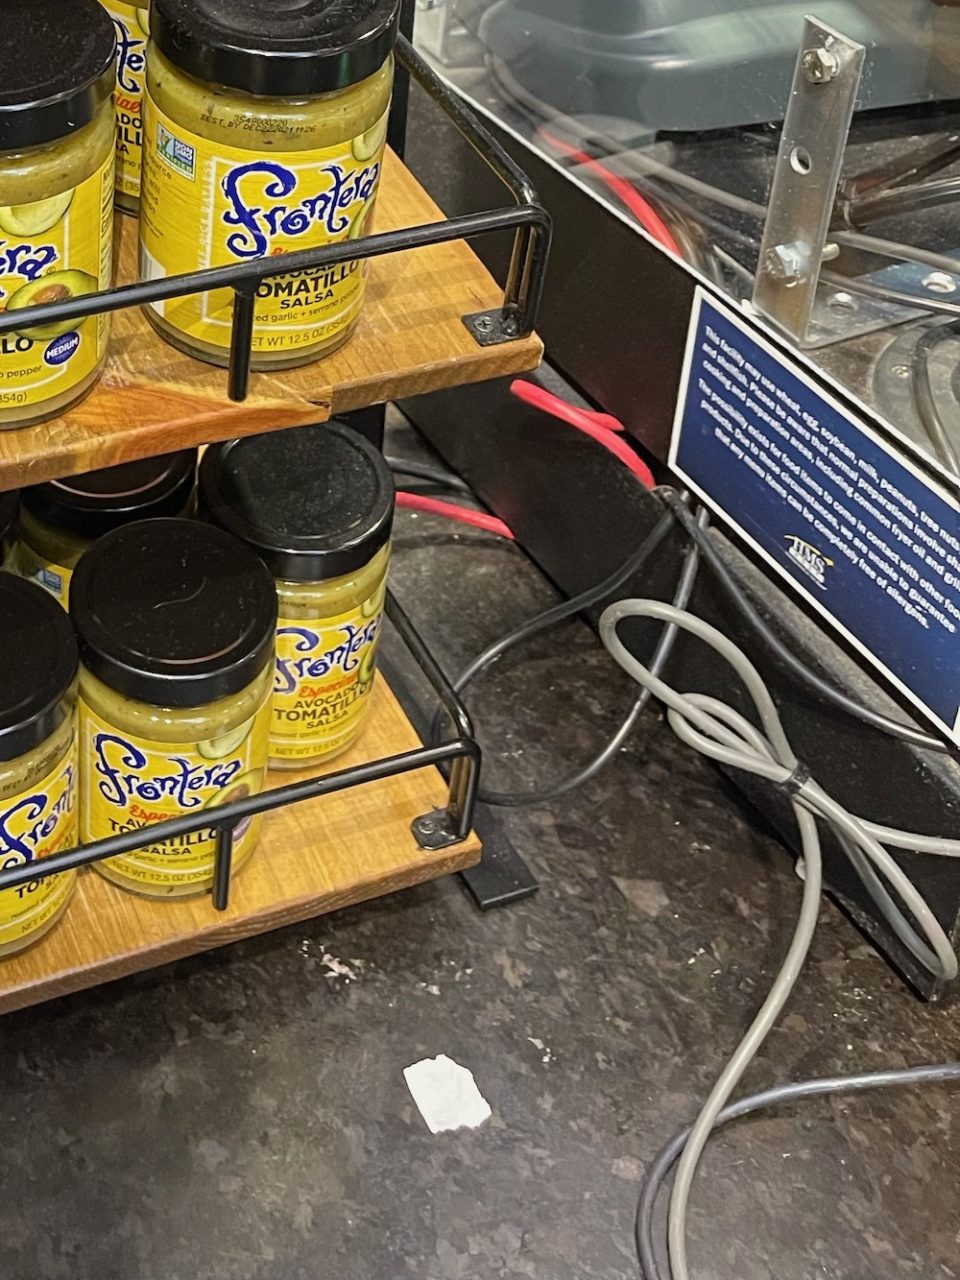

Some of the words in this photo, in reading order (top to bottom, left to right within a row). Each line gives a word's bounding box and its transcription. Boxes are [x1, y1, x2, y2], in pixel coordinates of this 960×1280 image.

[257, 261, 359, 298] OMATILLO
[280, 288, 335, 310] SALSA
[271, 311, 299, 324] garlic
[46, 336, 79, 359] MEDIUM
[267, 335, 286, 347] WT
[289, 332, 310, 345] 12.5
[311, 327, 326, 339] OZ
[7, 365, 43, 380] pepper
[706, 326, 720, 345] This
[720, 340, 746, 367] facility
[744, 360, 762, 380] may
[761, 376, 776, 392] use
[776, 388, 801, 416] wheat,
[821, 427, 857, 464] soybean,
[858, 459, 879, 483] milk,
[880, 479, 919, 517] peanuts,
[920, 511, 939, 532] tree
[702, 343, 717, 358] and
[717, 355, 748, 387] shellfish.
[750, 382, 775, 409] Please
[776, 404, 786, 419] be
[786, 416, 811, 440] aware
[811, 436, 828, 456] that
[828, 452, 858, 481] normal
[858, 478, 913, 529] preparations
[914, 524, 946, 557] involve
[703, 360, 732, 390] cooking
[730, 385, 746, 401] and
[746, 398, 790, 440] preparation
[790, 437, 814, 463] areas,
[816, 457, 854, 497] including
[853, 488, 891, 528] common
[892, 524, 914, 551] fryer
[912, 541, 927, 563] oil
[924, 549, 945, 579] and
[699, 378, 711, 395] The
[711, 392, 748, 429] possibility
[748, 425, 769, 448] exists
[770, 443, 783, 458] for
[782, 454, 800, 475] food
[800, 470, 823, 495] items
[822, 491, 833, 504] to
[833, 501, 857, 525] come
[856, 520, 866, 534] in
[866, 531, 900, 565] contact
[899, 557, 919, 581] with
[920, 579, 945, 607] other
[701, 400, 734, 433] products.
[735, 428, 750, 447] Due
[750, 443, 759, 455] to
[759, 451, 780, 474] these
[781, 472, 839, 529] circumstances,
[841, 525, 854, 543] we
[853, 538, 868, 553] are
[868, 551, 900, 581] unable
[898, 576, 910, 595] to
[907, 585, 957, 633] guarantee
[715, 428, 730, 446] that
[730, 443, 745, 459] any
[744, 455, 765, 478] menu
[764, 473, 787, 498] items
[786, 495, 802, 512] can
[803, 507, 814, 522] be
[814, 520, 860, 567] completely
[859, 559, 876, 579] free
[877, 577, 889, 593] of
[886, 581, 929, 628] allergens.
[293, 681, 360, 709] AVOCADO
[306, 710, 349, 729] SALSA
